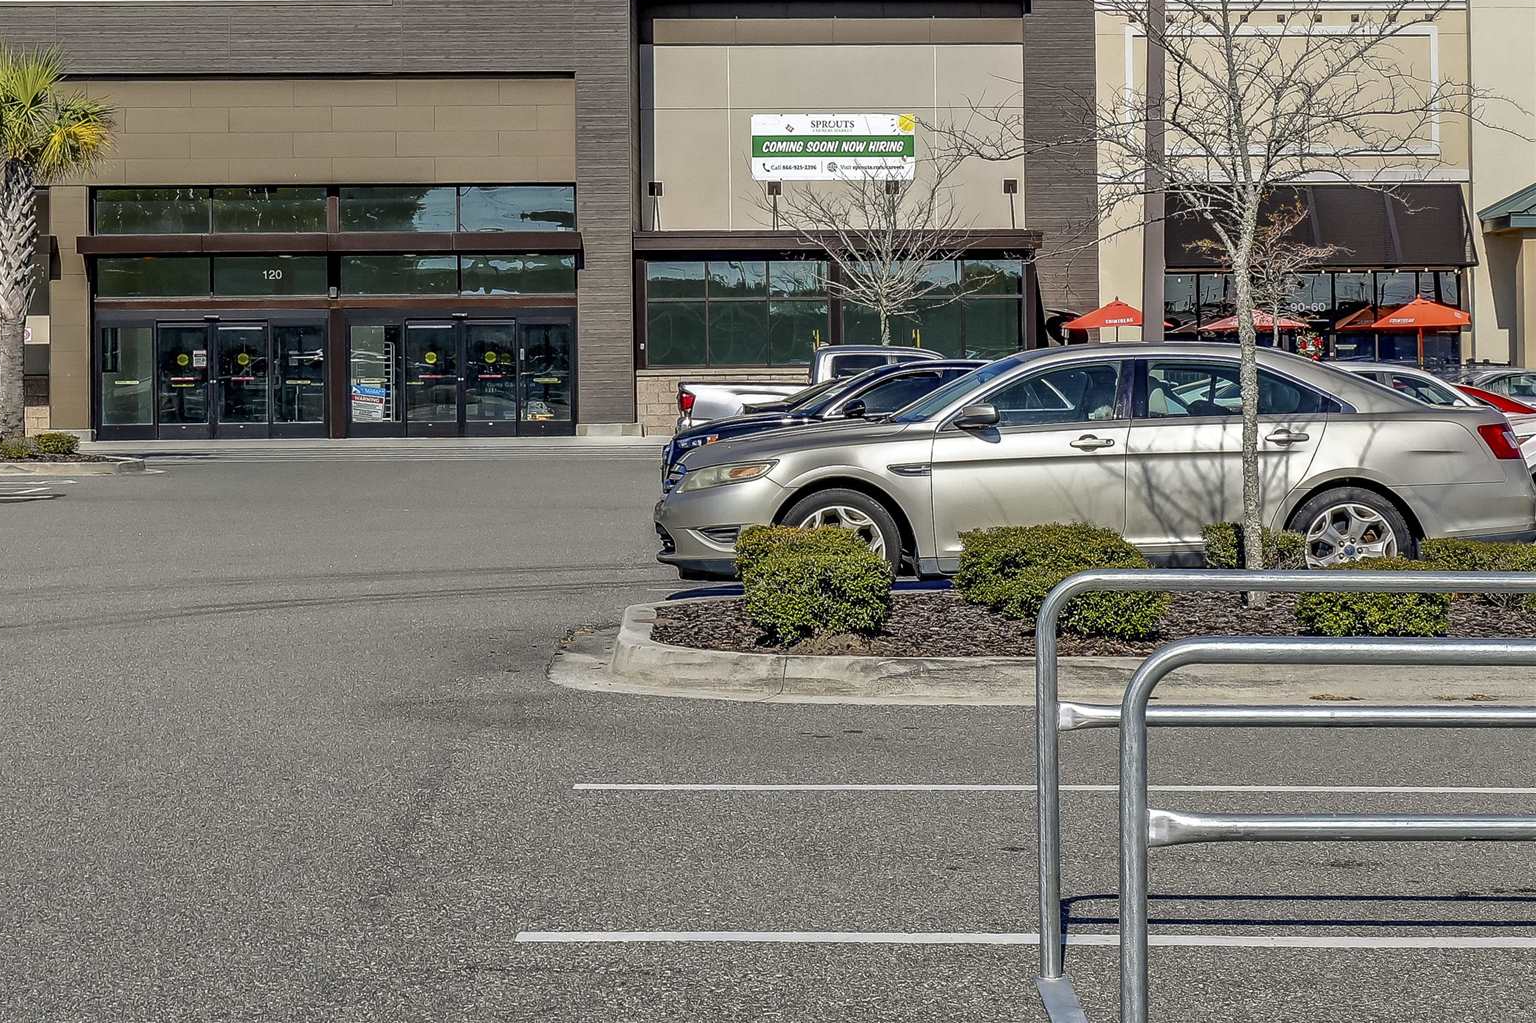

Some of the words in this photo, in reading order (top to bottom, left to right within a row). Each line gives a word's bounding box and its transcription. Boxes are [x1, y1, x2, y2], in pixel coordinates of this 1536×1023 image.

[810, 119, 855, 129] SPROUTS
[762, 141, 803, 153] COMING
[805, 140, 838, 153] SOON!
[841, 141, 866, 153] NOW
[869, 141, 904, 153] HIRING
[262, 269, 283, 280] 120
[1290, 302, 1326, 312] 90-60
